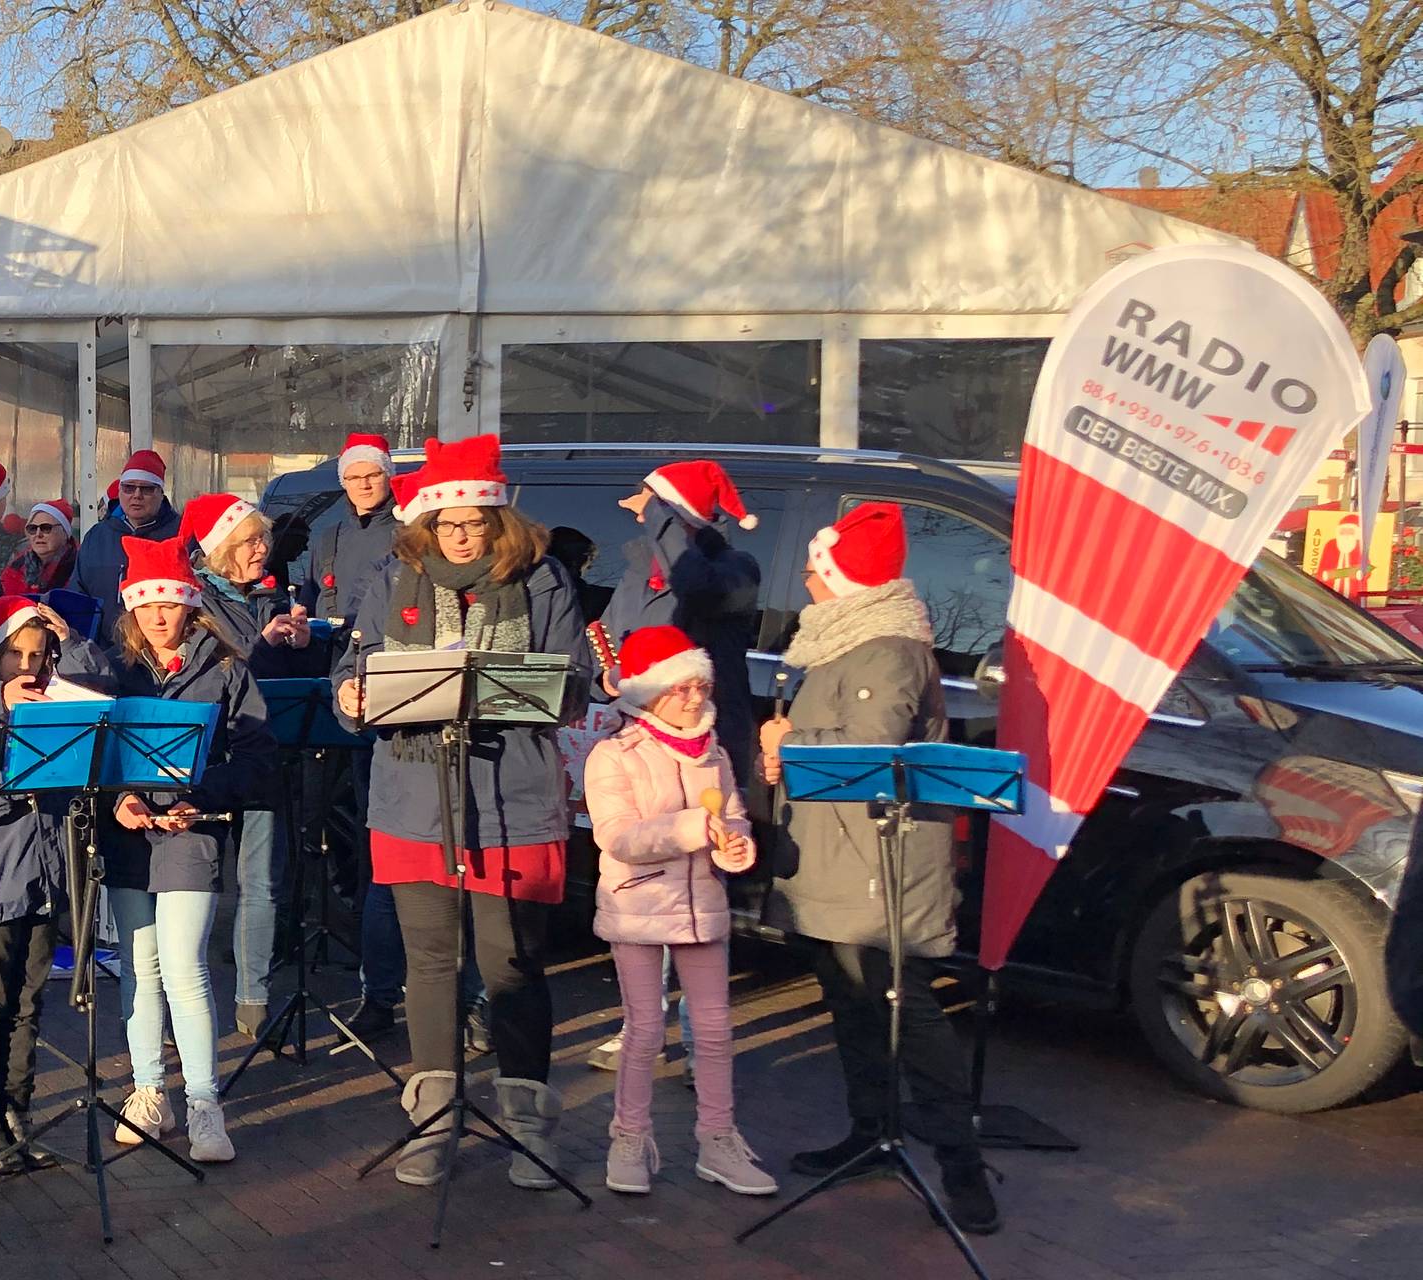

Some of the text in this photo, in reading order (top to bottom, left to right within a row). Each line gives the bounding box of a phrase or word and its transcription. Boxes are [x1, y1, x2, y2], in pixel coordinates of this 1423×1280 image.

[1101, 335, 1216, 410] WMW
[1116, 299, 1318, 415] RADIO
[1076, 414, 1236, 513] DER BESTE MIX.
[1081, 379, 1267, 485] 88.4 93.0 97.6 103.6
